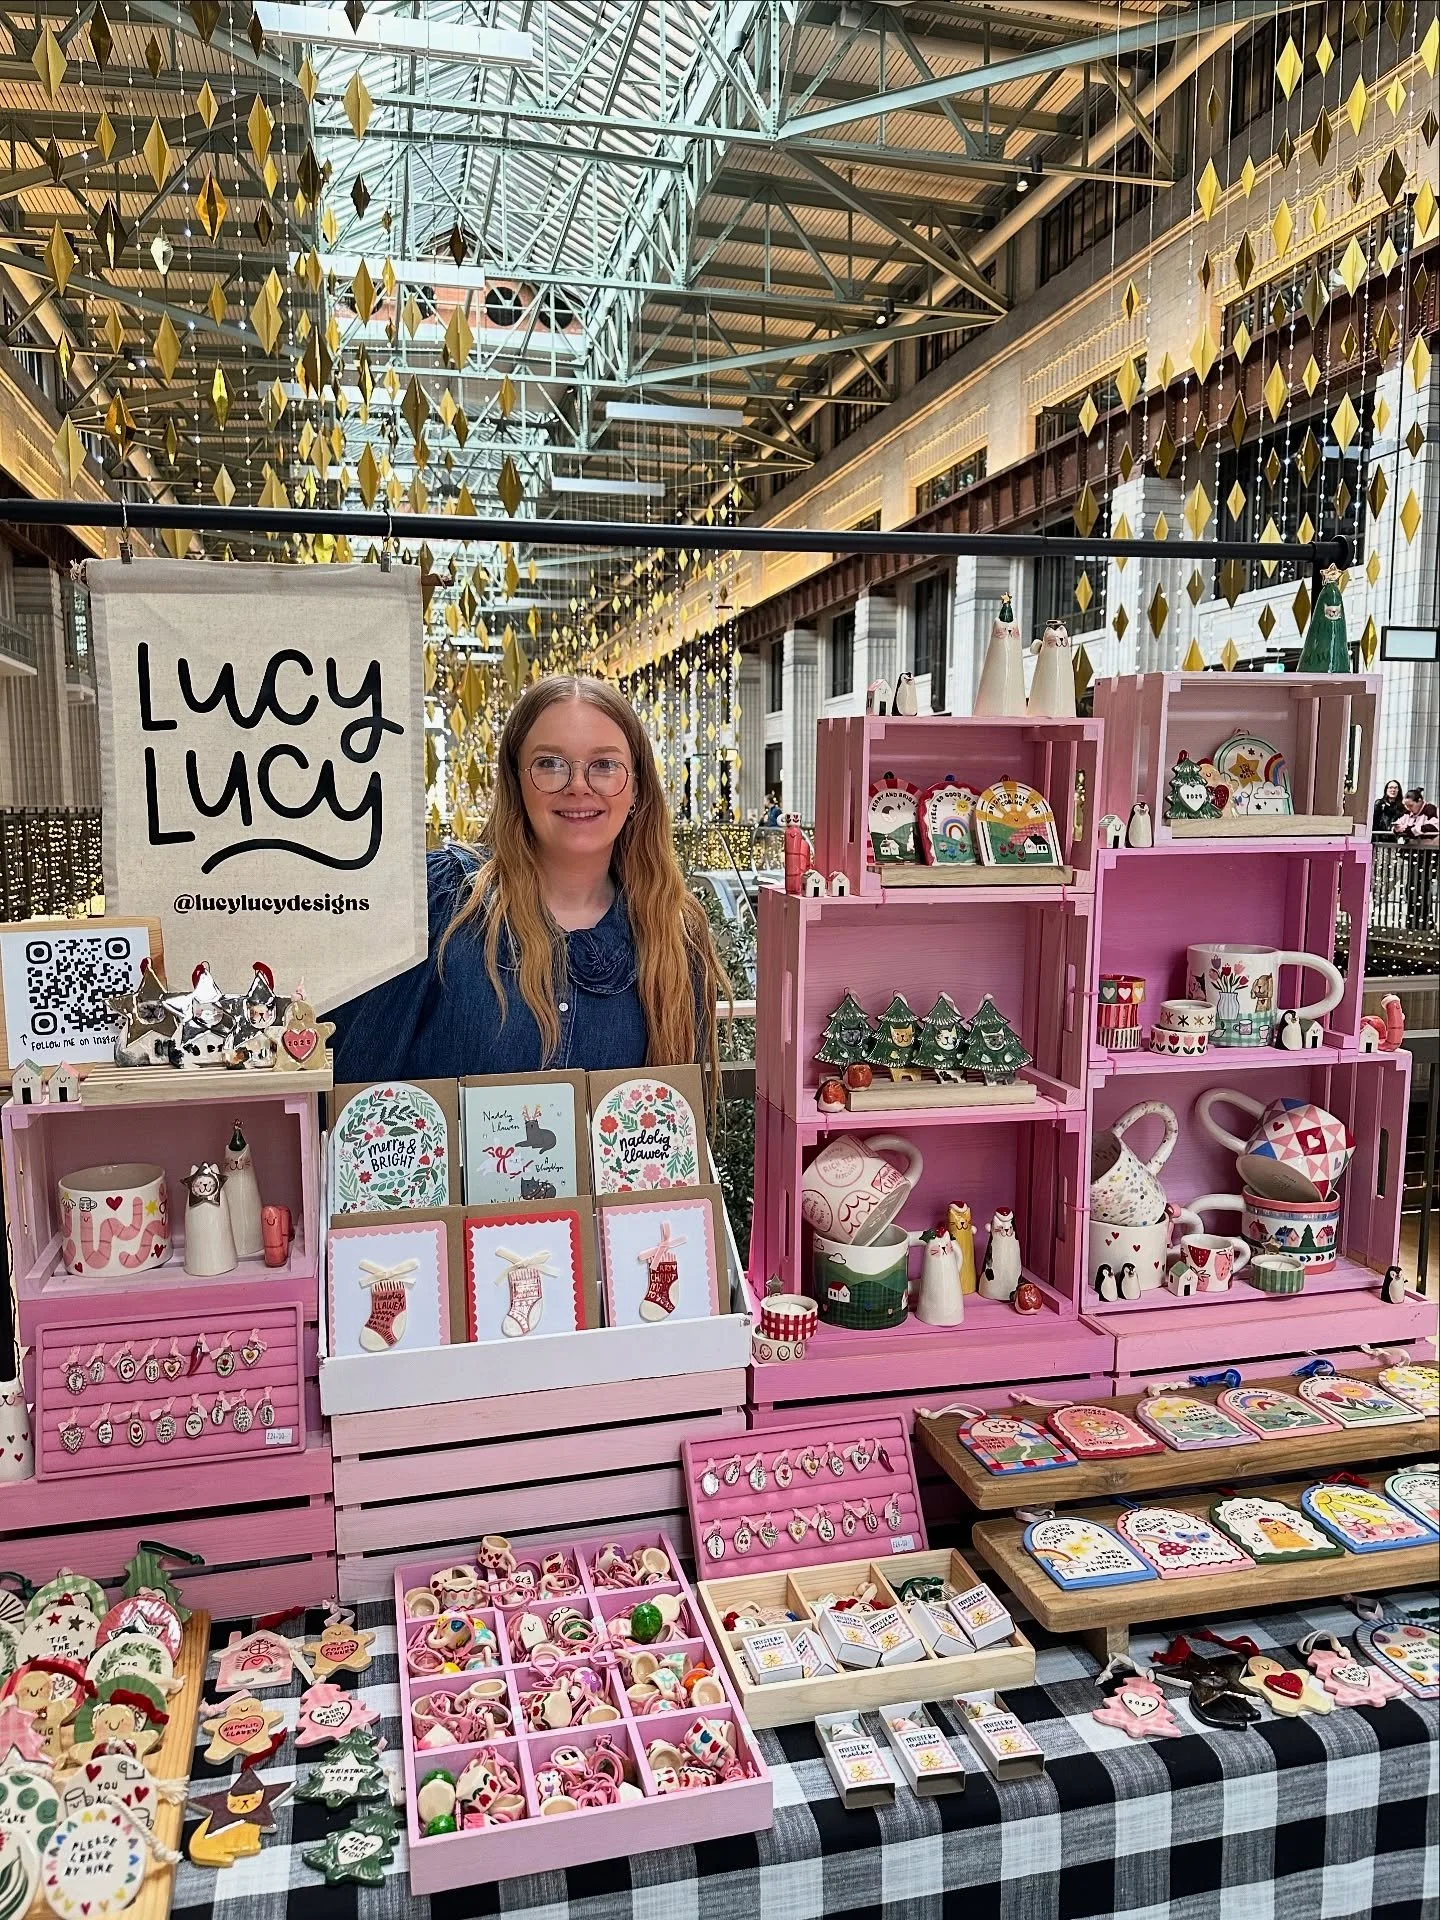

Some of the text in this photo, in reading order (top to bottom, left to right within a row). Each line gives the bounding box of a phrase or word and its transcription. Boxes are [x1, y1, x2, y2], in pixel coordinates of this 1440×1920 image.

[137, 642, 404, 763] Lucy
[1014, 794, 1030, 804] DAYS
[1030, 803, 1041, 815] ARE
[173, 892, 371, 915] @lucylucydesigns
[287, 1039, 311, 1047] 2025
[492, 1121, 520, 1133] Llawen
[619, 1128, 672, 1152] nadolig
[406, 1138, 417, 1156] &
[623, 1147, 670, 1164] llawen
[371, 1152, 415, 1173] BRIGHT
[822, 1160, 841, 1174] RICH
[957, 1591, 984, 1607] MYSTERY
[870, 1613, 896, 1630] MYSTERY
[47, 1635, 68, 1644] 'TIS
[752, 1636, 782, 1647] MYSTERY
[52, 1643, 70, 1651] THE
[1128, 1699, 1153, 1708] 2025
[317, 1706, 344, 1717] MERRY
[325, 1711, 342, 1719] AND
[983, 1719, 1013, 1730] MYSTERY
[226, 1728, 258, 1737] LLAWEN
[906, 1733, 937, 1743] MYSTERY
[838, 1743, 870, 1754] MYSTERY
[97, 1781, 118, 1792] YOU
[71, 1834, 118, 1852] PLEASE
[70, 1850, 112, 1863] LEAVE
[64, 1866, 80, 1877] BY
